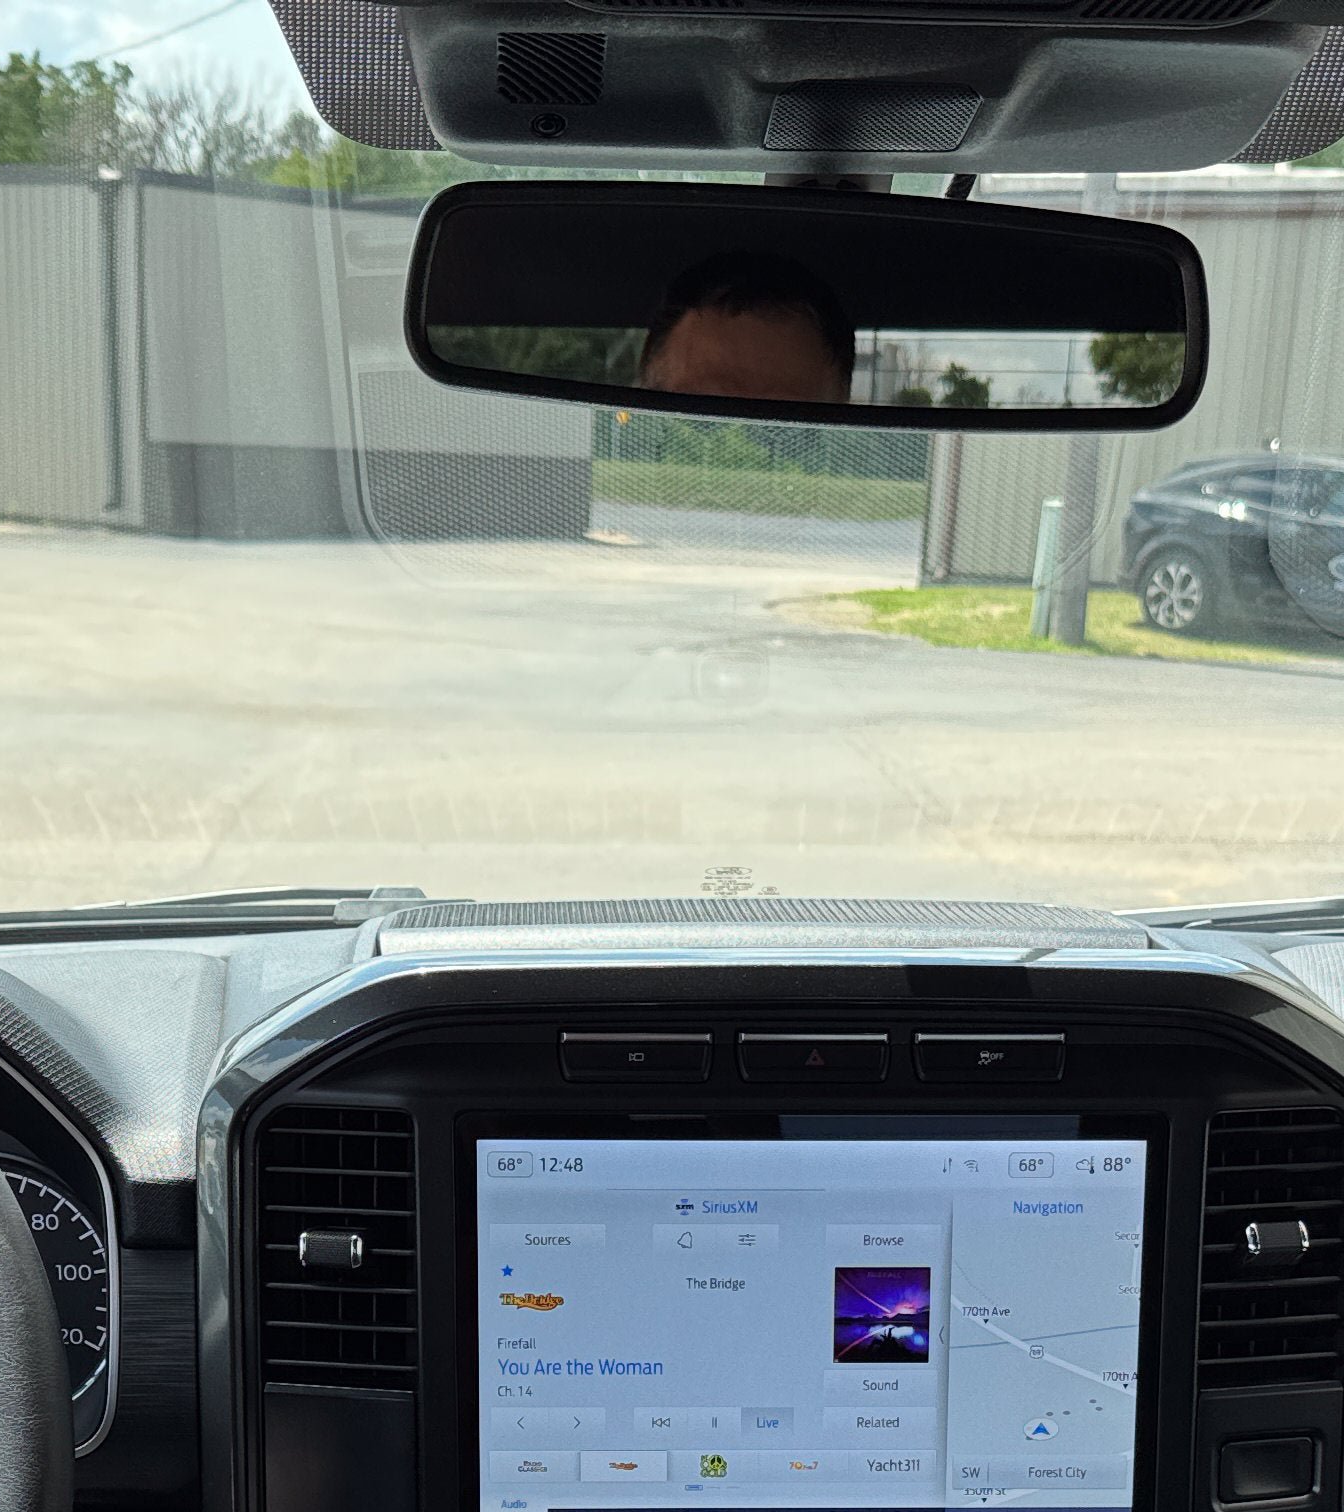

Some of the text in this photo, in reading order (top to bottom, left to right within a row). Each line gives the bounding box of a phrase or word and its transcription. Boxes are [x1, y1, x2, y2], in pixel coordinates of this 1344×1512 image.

[497, 1157, 584, 1173] 68° 12:48
[1018, 1158, 1044, 1173] 68°
[1103, 1156, 1132, 1173] 88°
[702, 1200, 758, 1214] SiriusXM
[1013, 1201, 1084, 1216] Navigation
[31, 1213, 59, 1231] 80
[524, 1233, 571, 1246] Sources
[863, 1234, 905, 1246] Browse
[55, 1264, 92, 1281] 100
[686, 1277, 746, 1291] The Bridge
[962, 1306, 1010, 1317] 170th Ave
[497, 1337, 537, 1350] Firefall
[497, 1359, 664, 1376] You Are the Woman
[1102, 1371, 1130, 1382] 170th
[497, 1385, 533, 1398] Ch. 14
[862, 1380, 899, 1391] Sound
[757, 1417, 780, 1429] Live
[856, 1416, 900, 1428] Related
[867, 1459, 921, 1472] Yacht311
[961, 1467, 981, 1478] SW
[1028, 1467, 1087, 1480] Forest City
[501, 1499, 527, 1509] Audio
